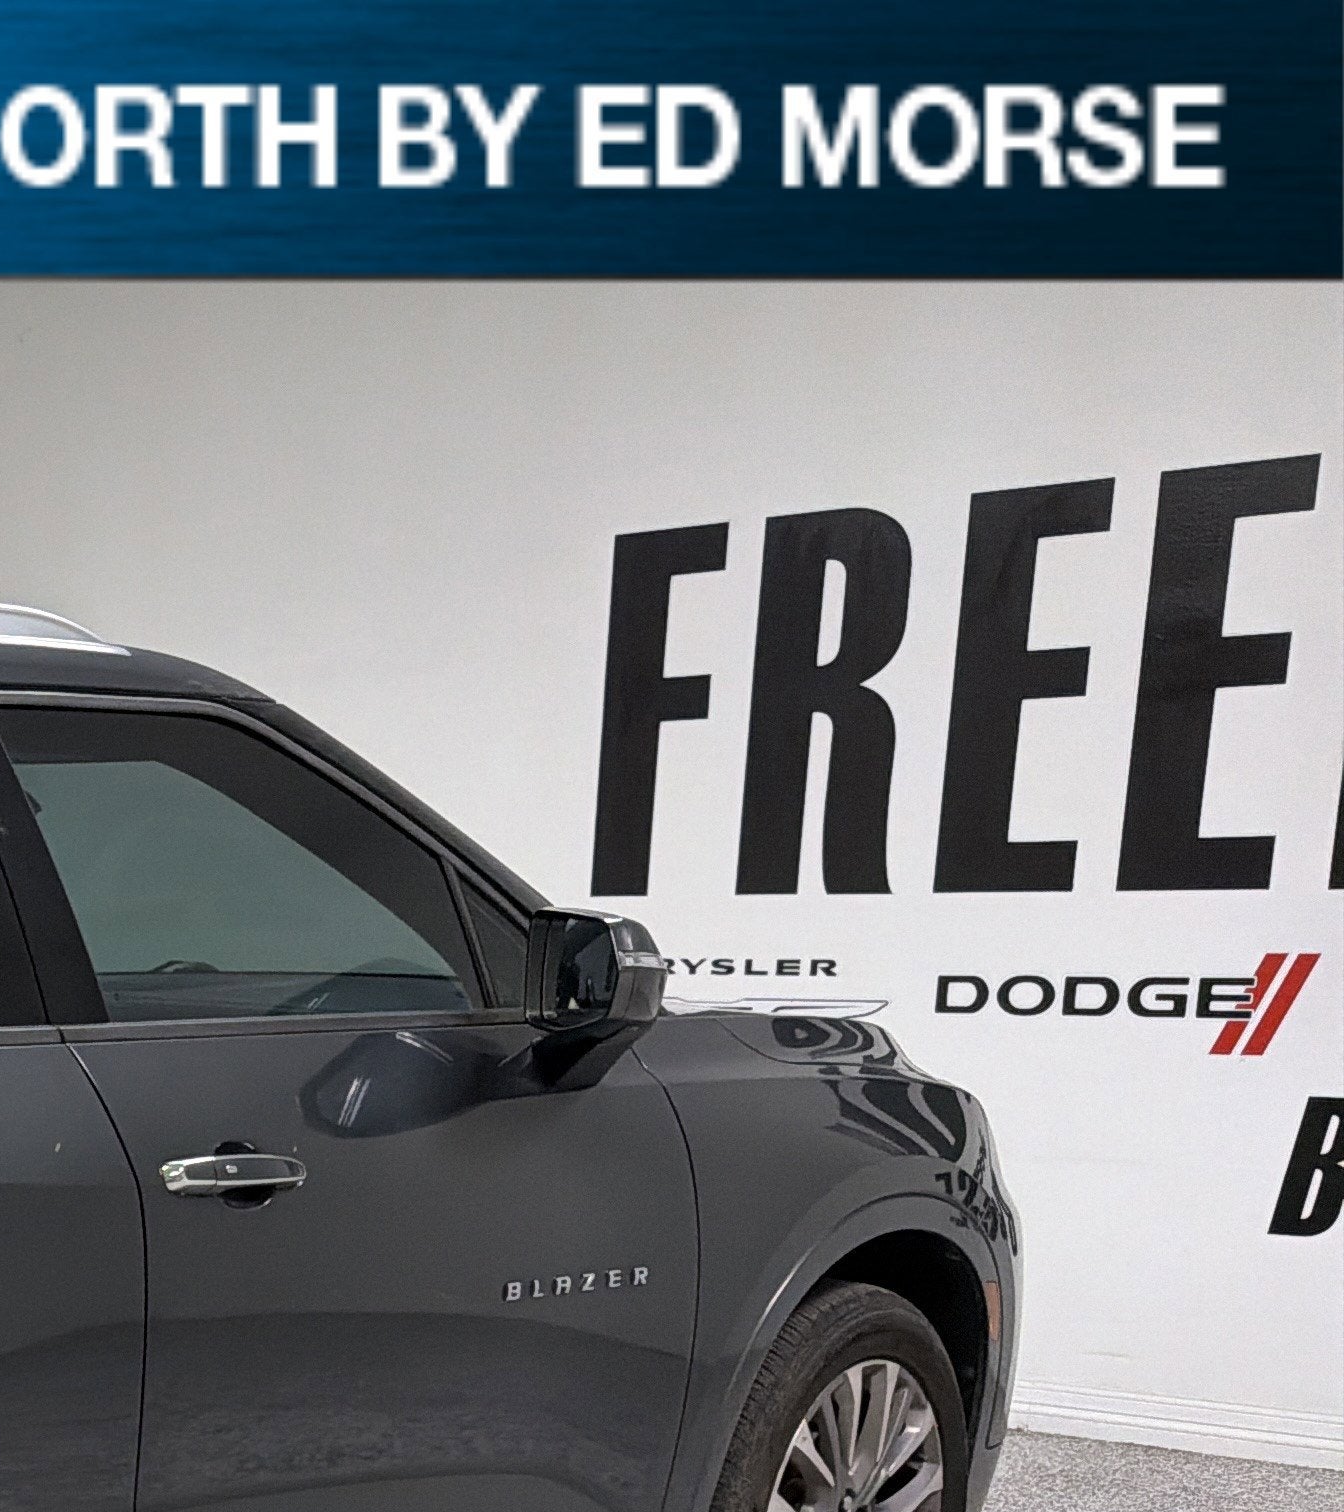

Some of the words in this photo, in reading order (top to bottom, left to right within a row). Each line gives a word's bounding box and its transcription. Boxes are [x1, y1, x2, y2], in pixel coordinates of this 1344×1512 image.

[591, 453, 1344, 897] FREE
[935, 975, 1256, 1019] DODGE
[505, 1266, 649, 1301] BLAZER
